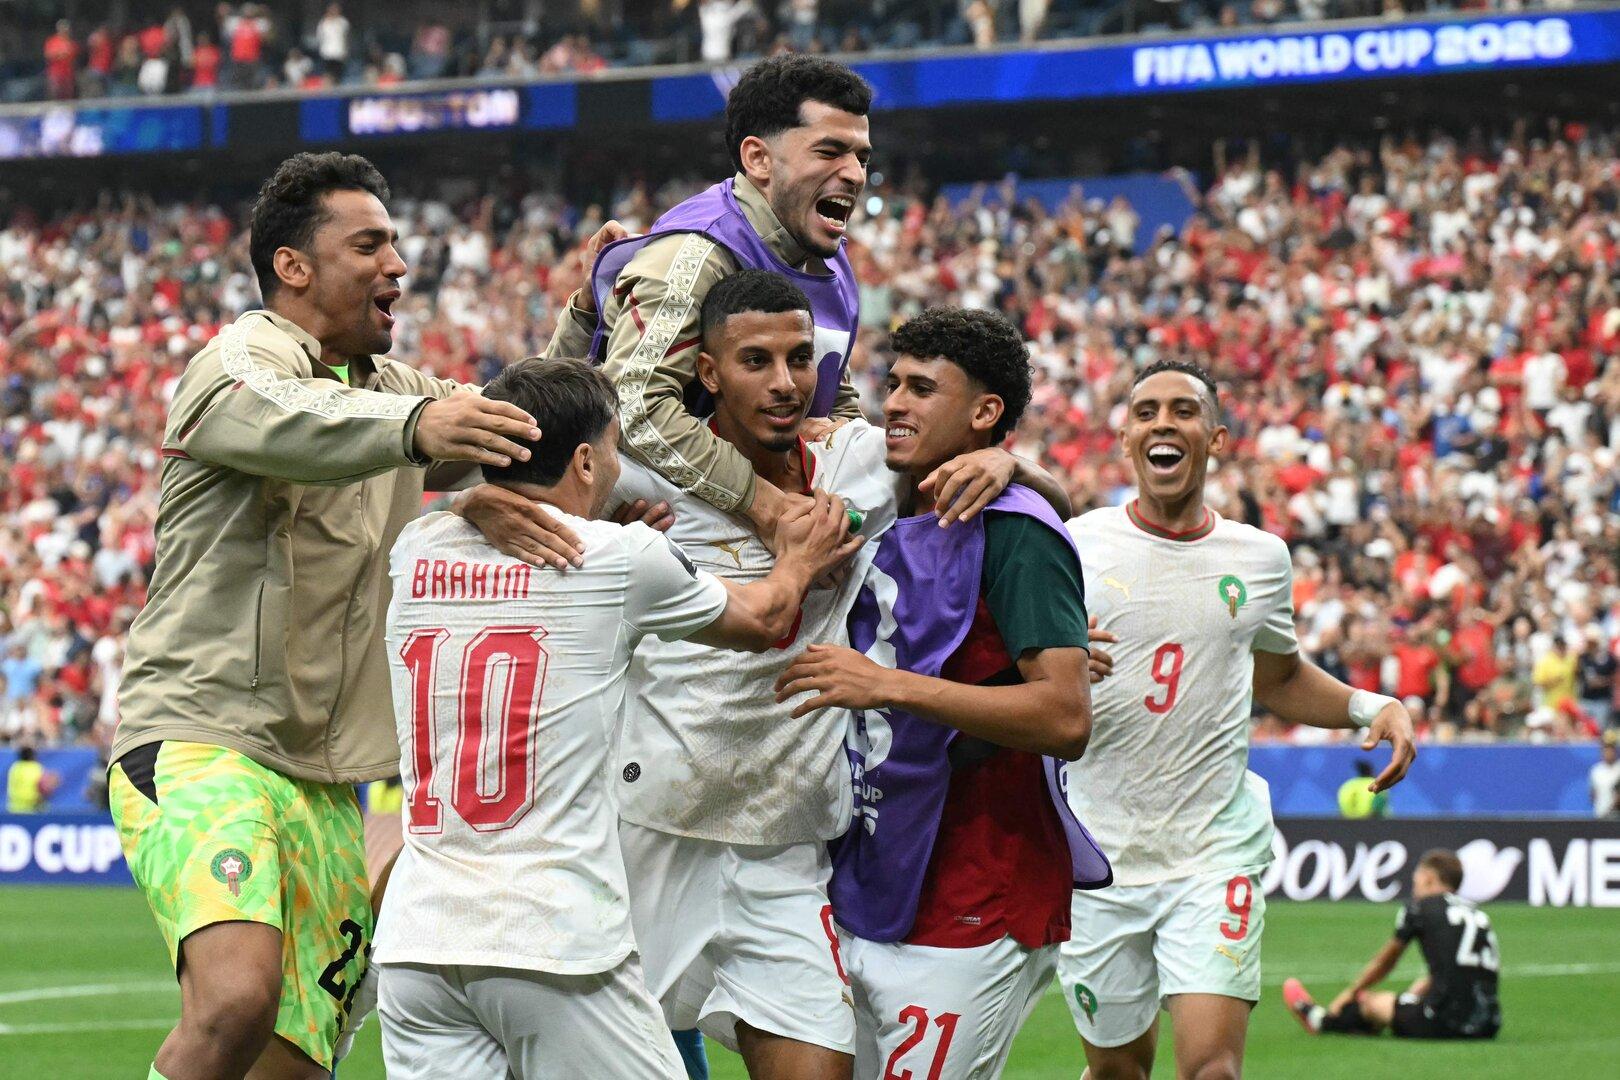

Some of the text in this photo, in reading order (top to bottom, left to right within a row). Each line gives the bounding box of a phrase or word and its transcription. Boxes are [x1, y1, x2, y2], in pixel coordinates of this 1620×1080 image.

[1134, 18, 1573, 86] FIFA WORLD CUP 2026
[412, 559, 531, 599] BRAHIM
[1144, 643, 1184, 714] 9
[400, 625, 549, 834] 10
[34, 824, 122, 872] CUP
[1529, 839, 1620, 907] ME
[1219, 876, 1252, 940] 9
[883, 1004, 961, 1080] 21
